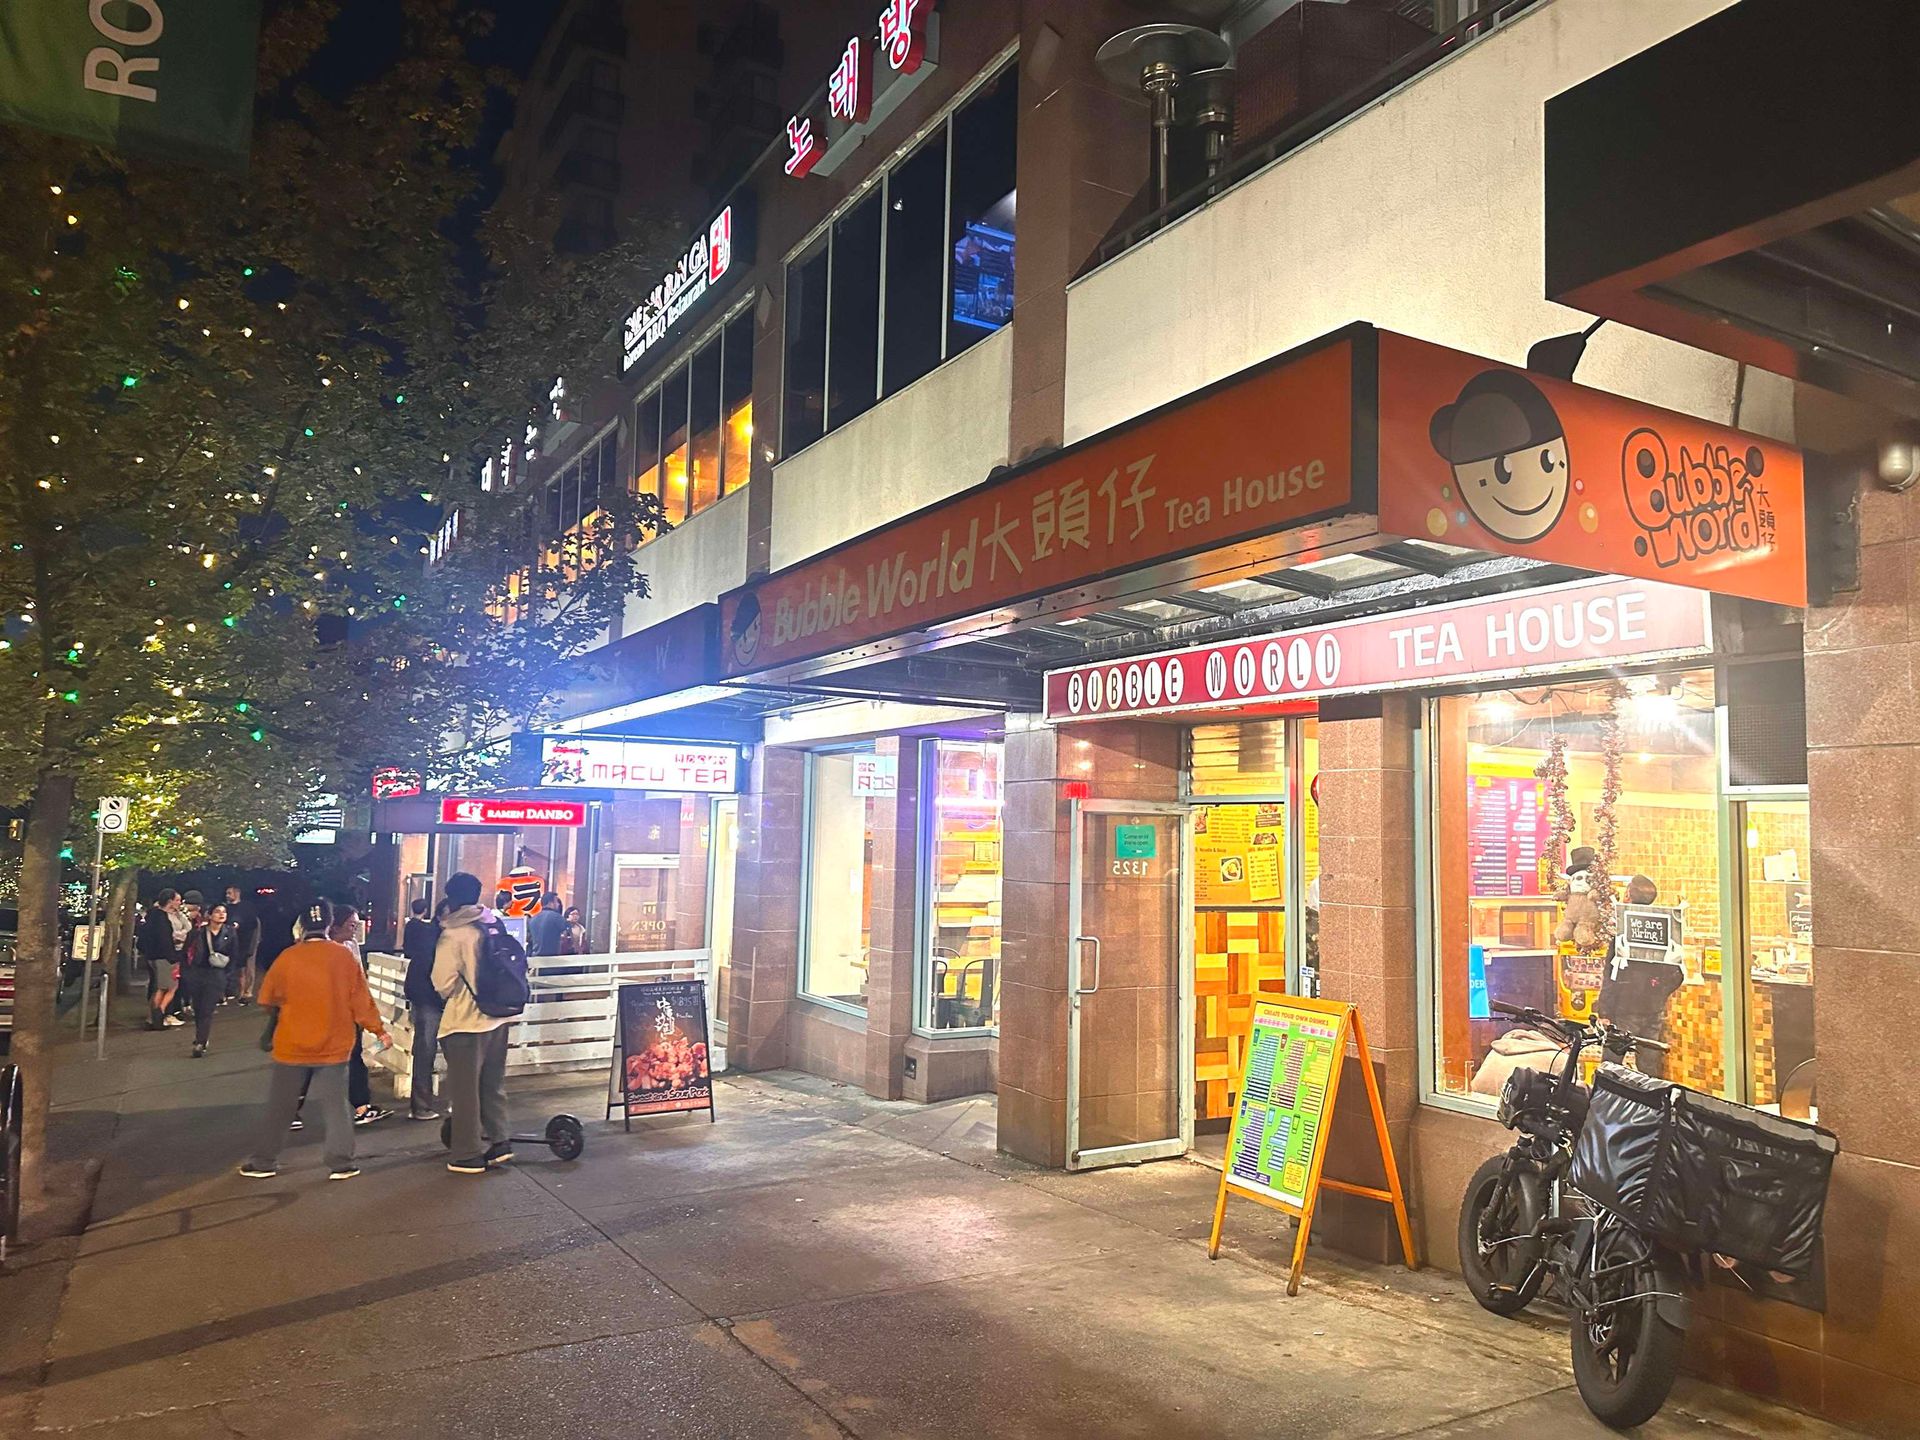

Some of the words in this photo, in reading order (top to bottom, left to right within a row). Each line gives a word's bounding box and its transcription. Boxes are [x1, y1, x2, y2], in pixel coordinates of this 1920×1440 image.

[771, 567, 861, 647] Bubble
[866, 517, 980, 618] World
[981, 454, 1157, 582] 大頭仔
[1164, 496, 1212, 534] Tea
[1223, 458, 1326, 518] House
[1070, 661, 1181, 710] BUBBLE
[1207, 639, 1340, 690] WORLD
[1389, 621, 1464, 669] TEA
[1486, 590, 1647, 658] HOUSE
[592, 763, 664, 782] MACU
[678, 767, 727, 784] TEA
[526, 808, 574, 820] DANBO
[1630, 918, 1643, 928] We
[1645, 920, 1663, 930] are
